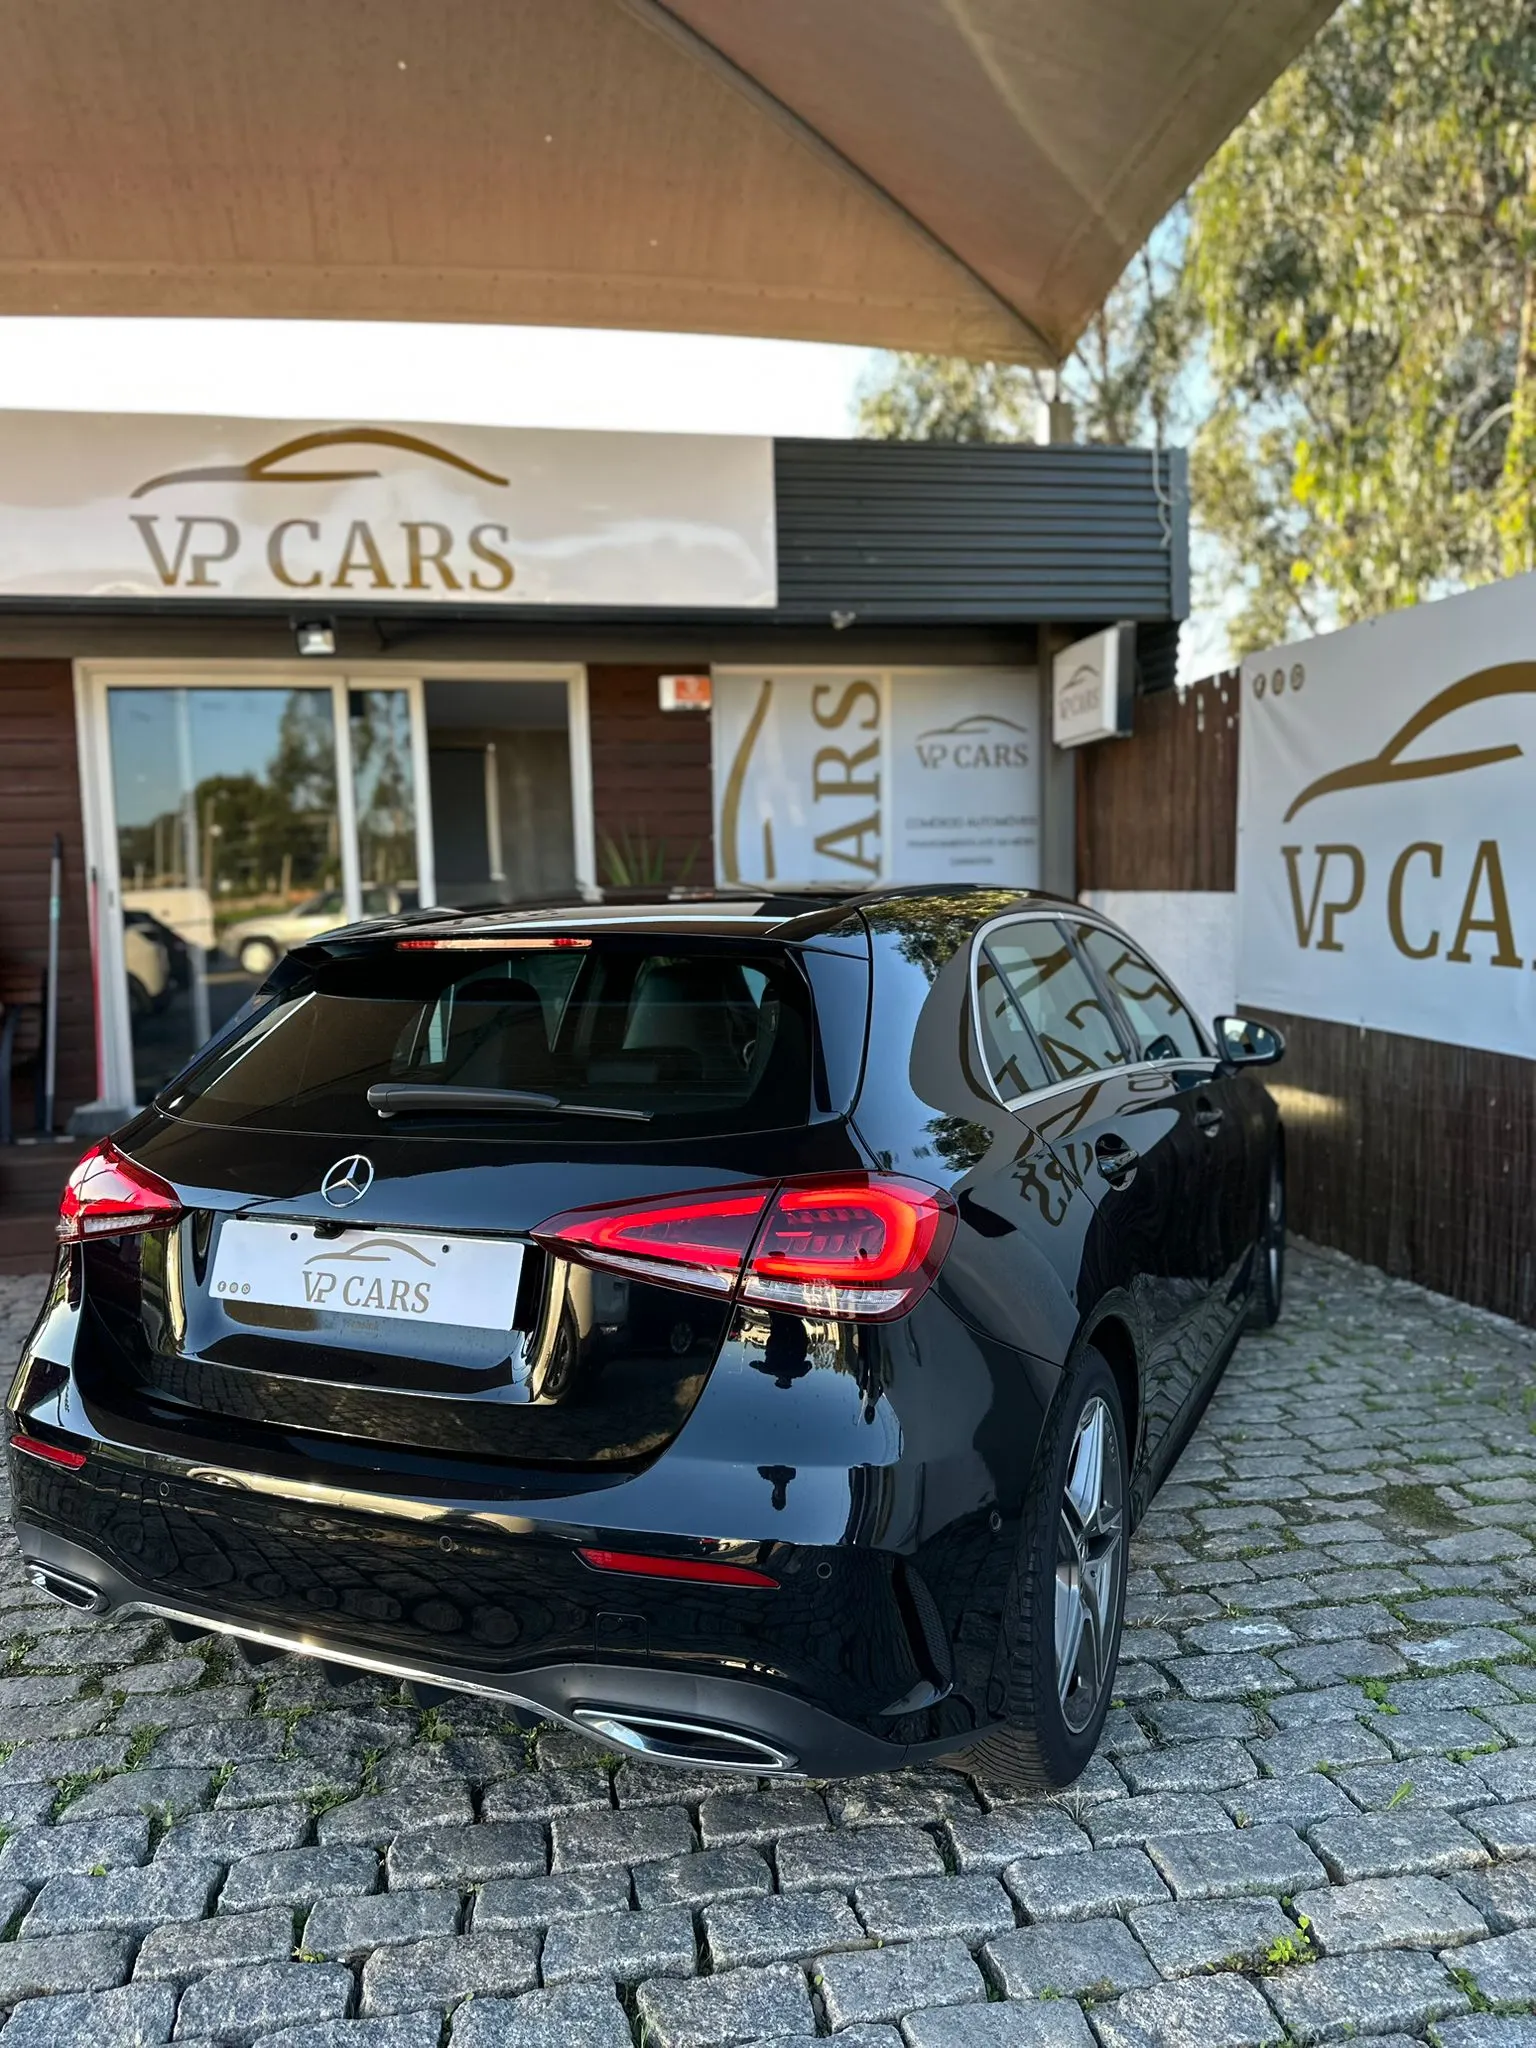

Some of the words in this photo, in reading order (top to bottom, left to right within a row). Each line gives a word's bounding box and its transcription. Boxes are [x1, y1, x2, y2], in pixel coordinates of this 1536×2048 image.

[128, 513, 241, 588] VP
[265, 517, 516, 593] CARS
[914, 744, 948, 769] VP
[952, 743, 1030, 770] CARS
[1280, 843, 1366, 953] VP
[1387, 839, 1536, 973] CA
[301, 1270, 337, 1304] VP
[342, 1275, 432, 1314] CARS
